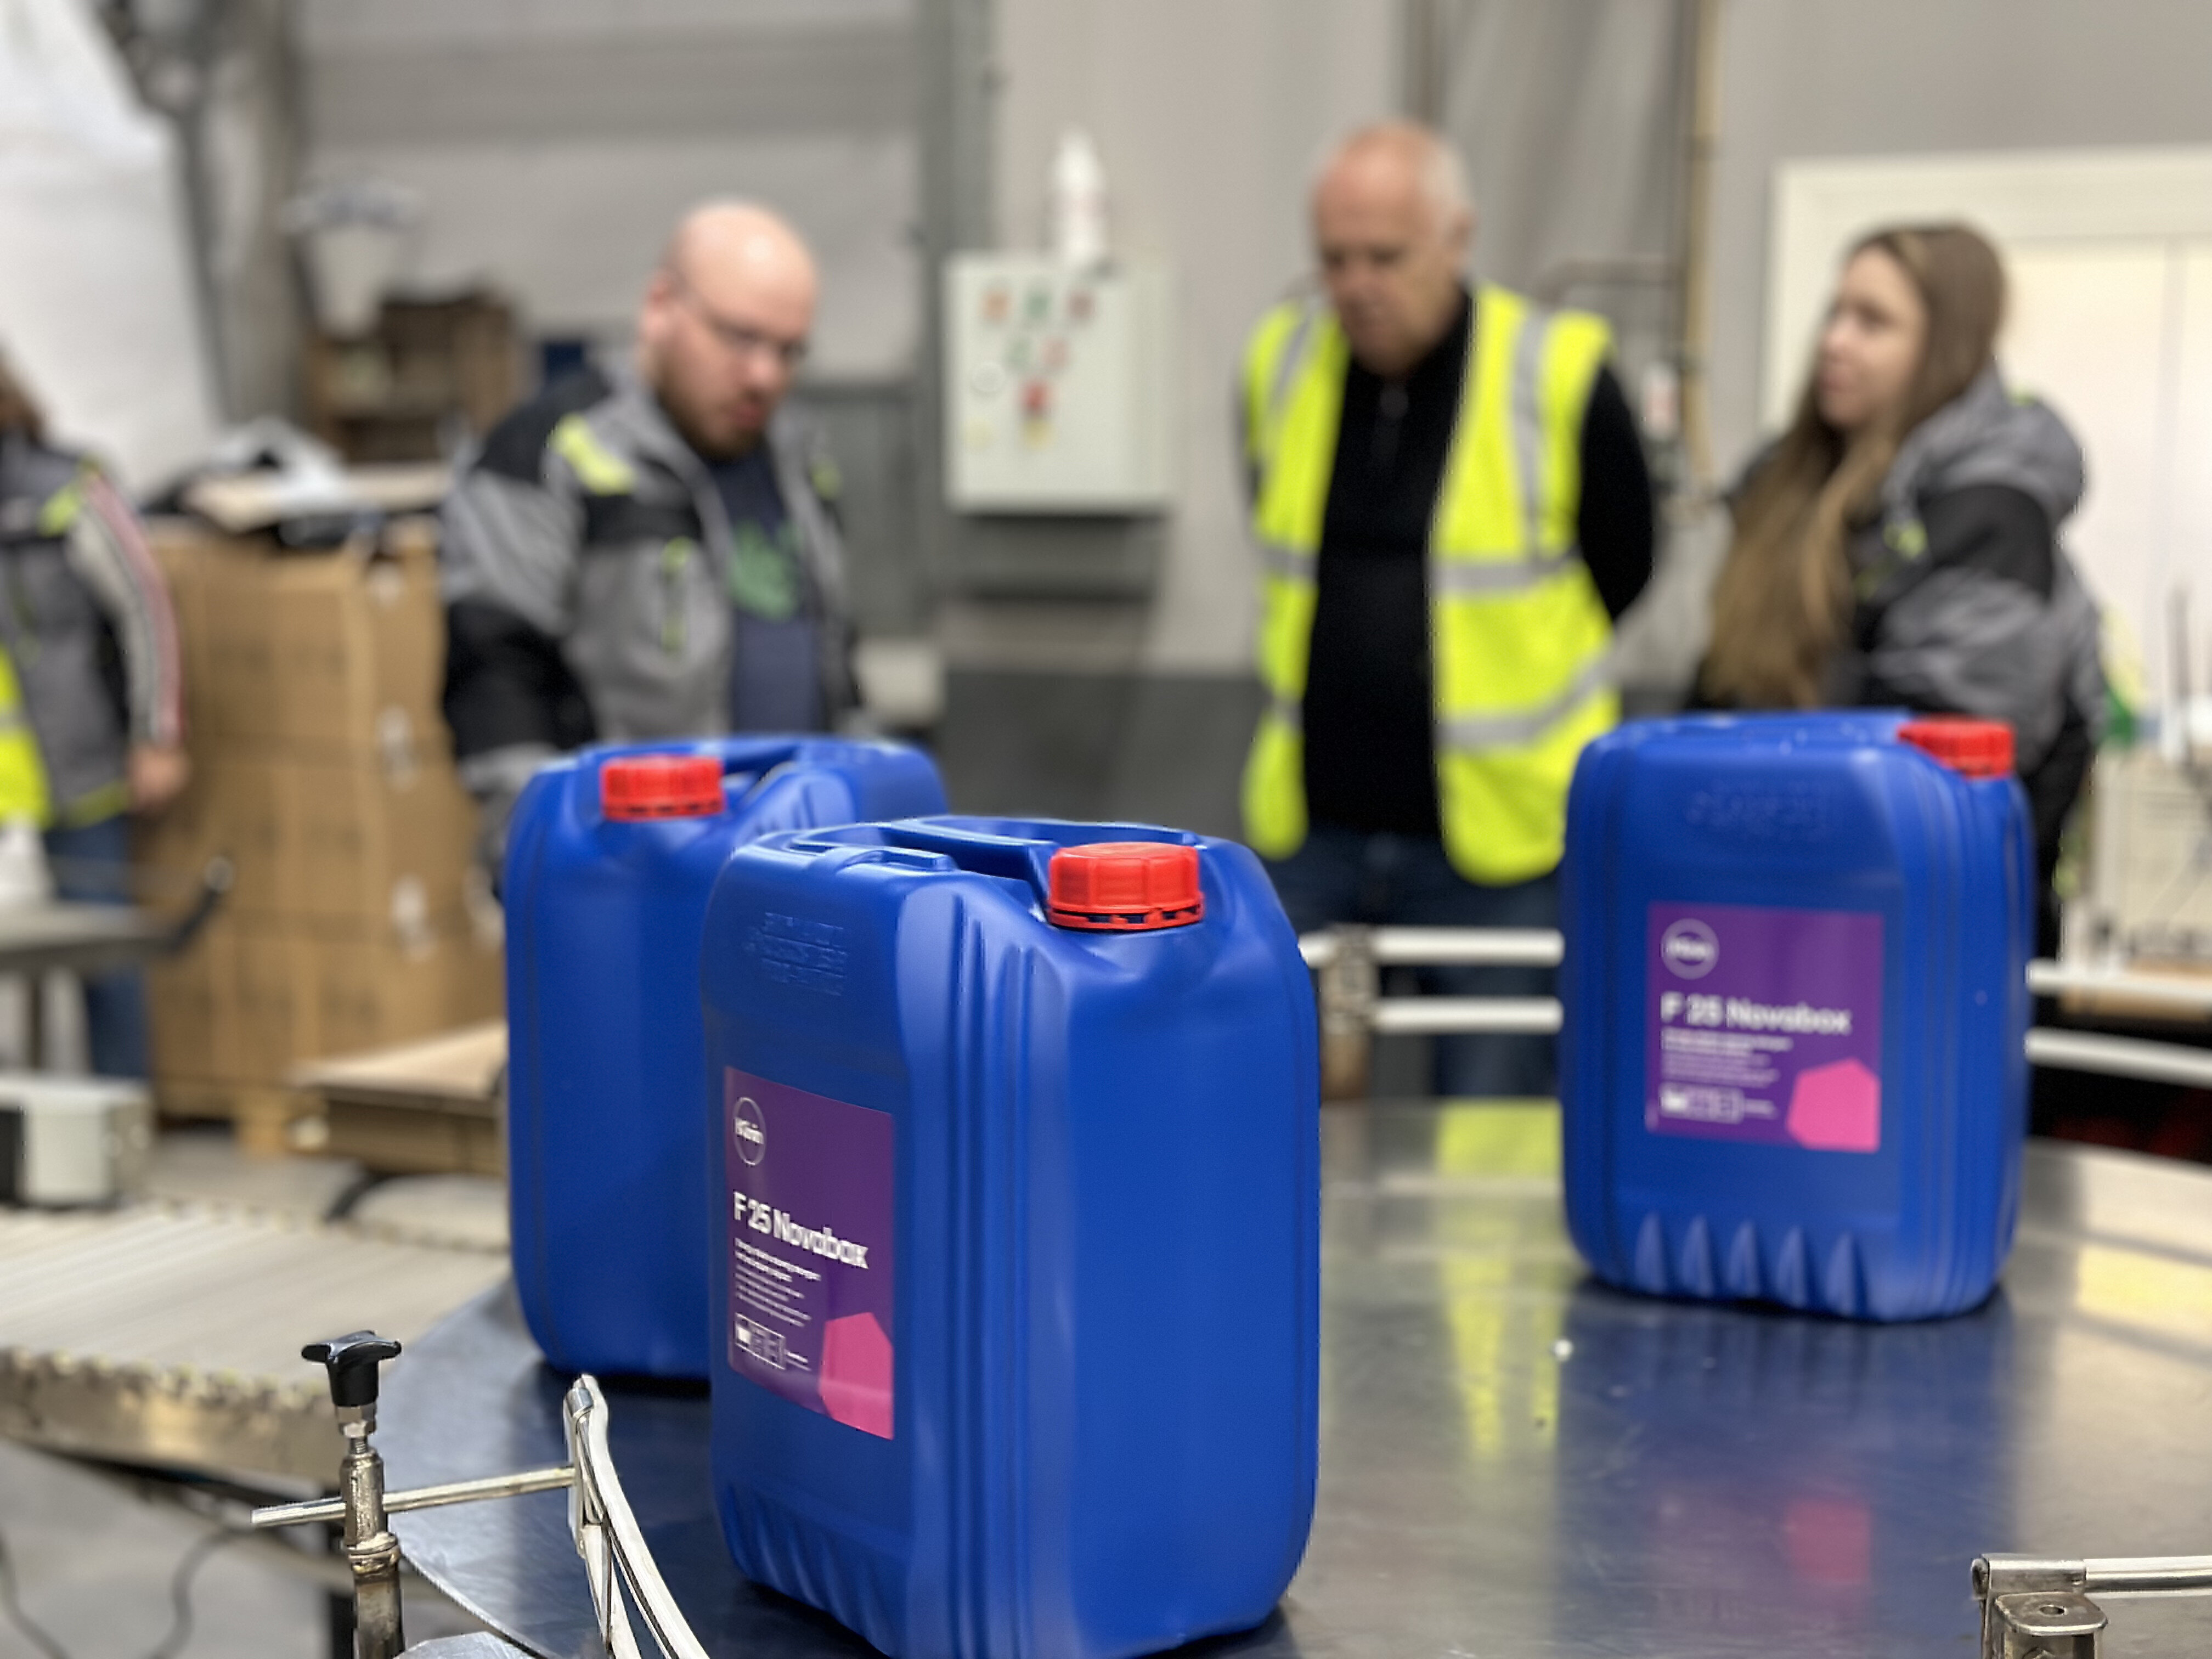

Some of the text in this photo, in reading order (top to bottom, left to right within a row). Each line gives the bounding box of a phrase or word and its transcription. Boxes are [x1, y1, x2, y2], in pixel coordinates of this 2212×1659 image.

[733, 1191, 747, 1221] F
[748, 1198, 771, 1234] 25
[772, 1209, 868, 1269] Novabox
